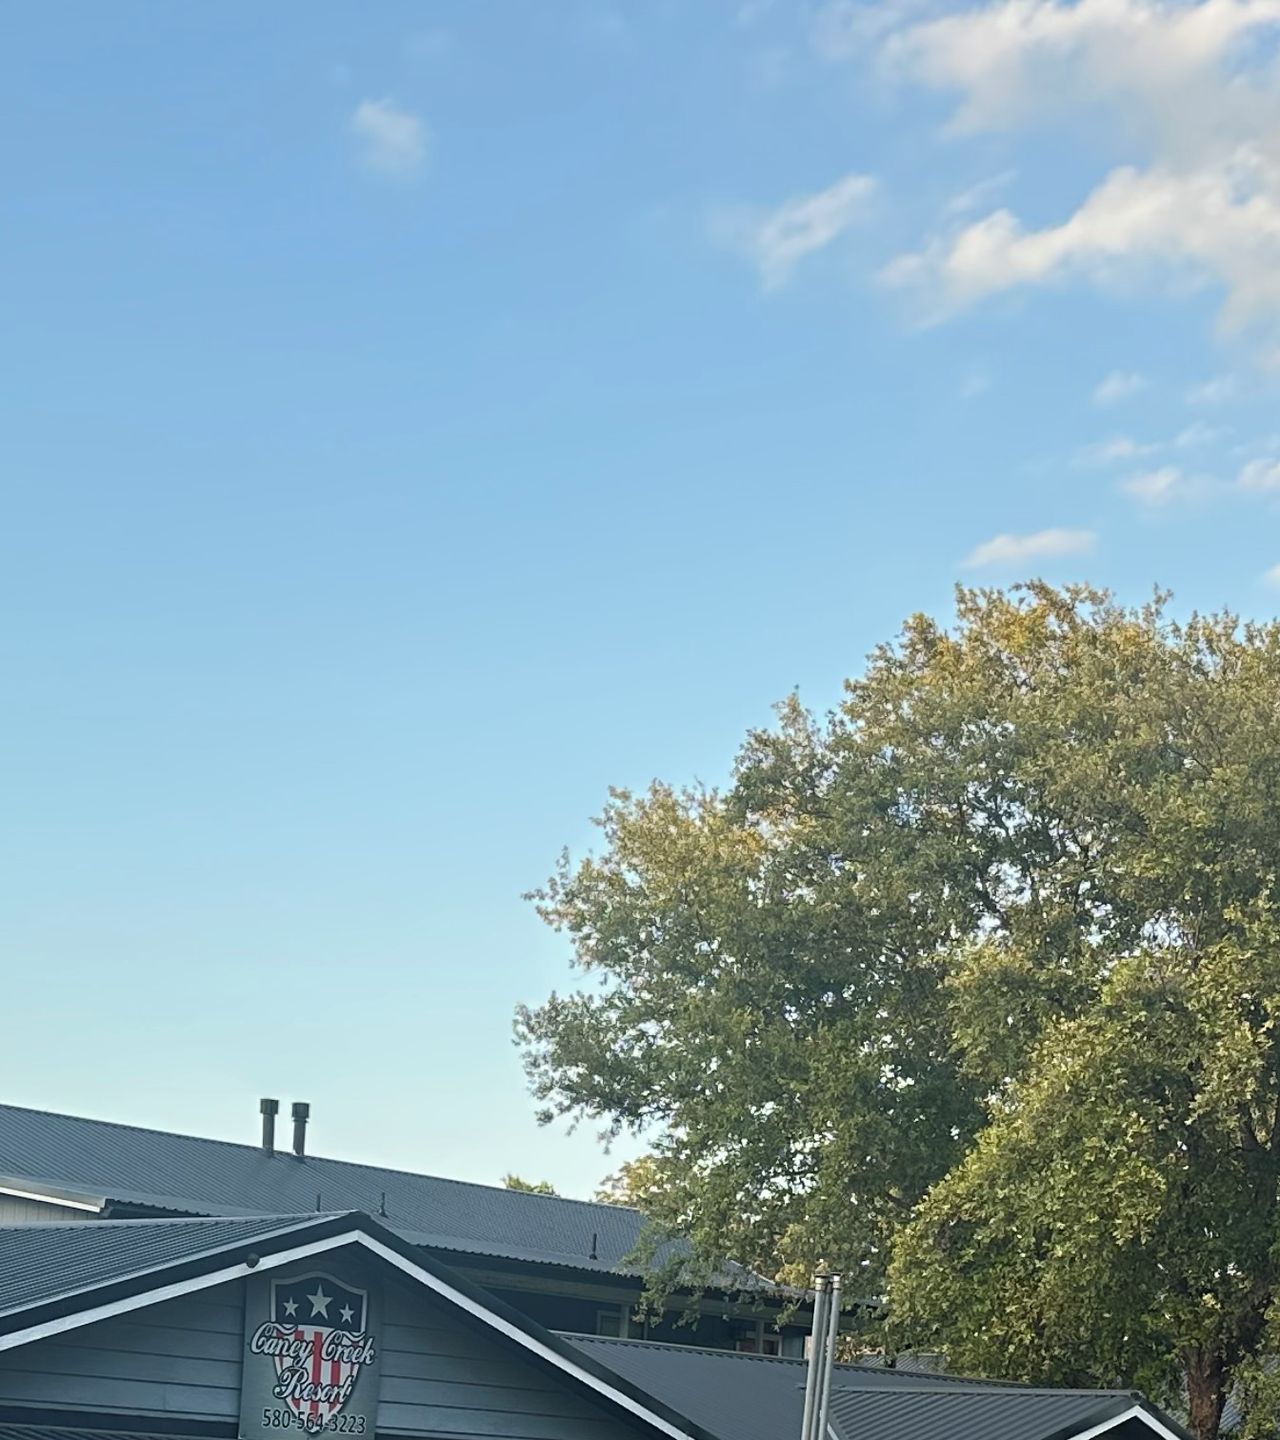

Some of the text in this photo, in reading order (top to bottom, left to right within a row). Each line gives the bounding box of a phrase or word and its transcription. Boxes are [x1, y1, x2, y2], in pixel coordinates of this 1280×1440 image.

[250, 1320, 376, 1368] Caney Creek
[273, 1366, 356, 1404] Resort
[261, 1407, 368, 1435] 580-564-3223
